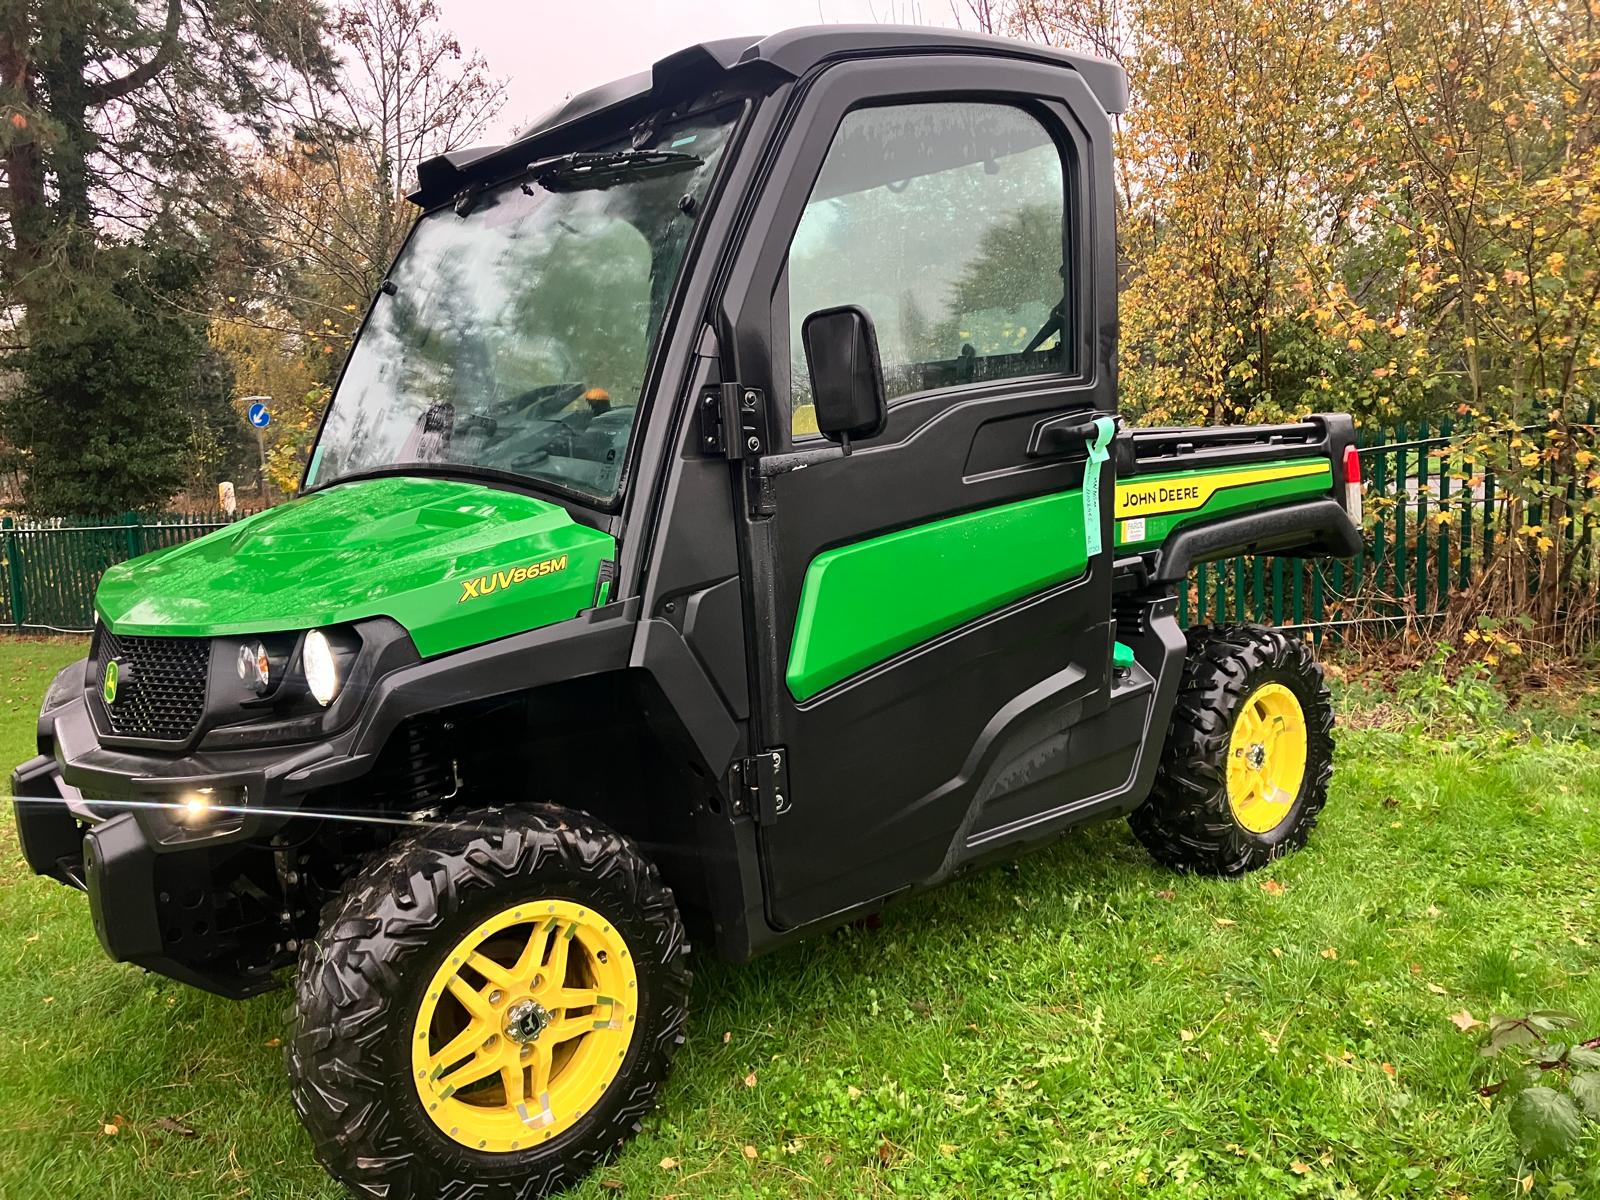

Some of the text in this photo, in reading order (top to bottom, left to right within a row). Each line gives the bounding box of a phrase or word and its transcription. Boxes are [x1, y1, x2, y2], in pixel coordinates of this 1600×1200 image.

[1122, 486, 1199, 507] JOHN DEERE
[459, 554, 568, 603] XUV865M
